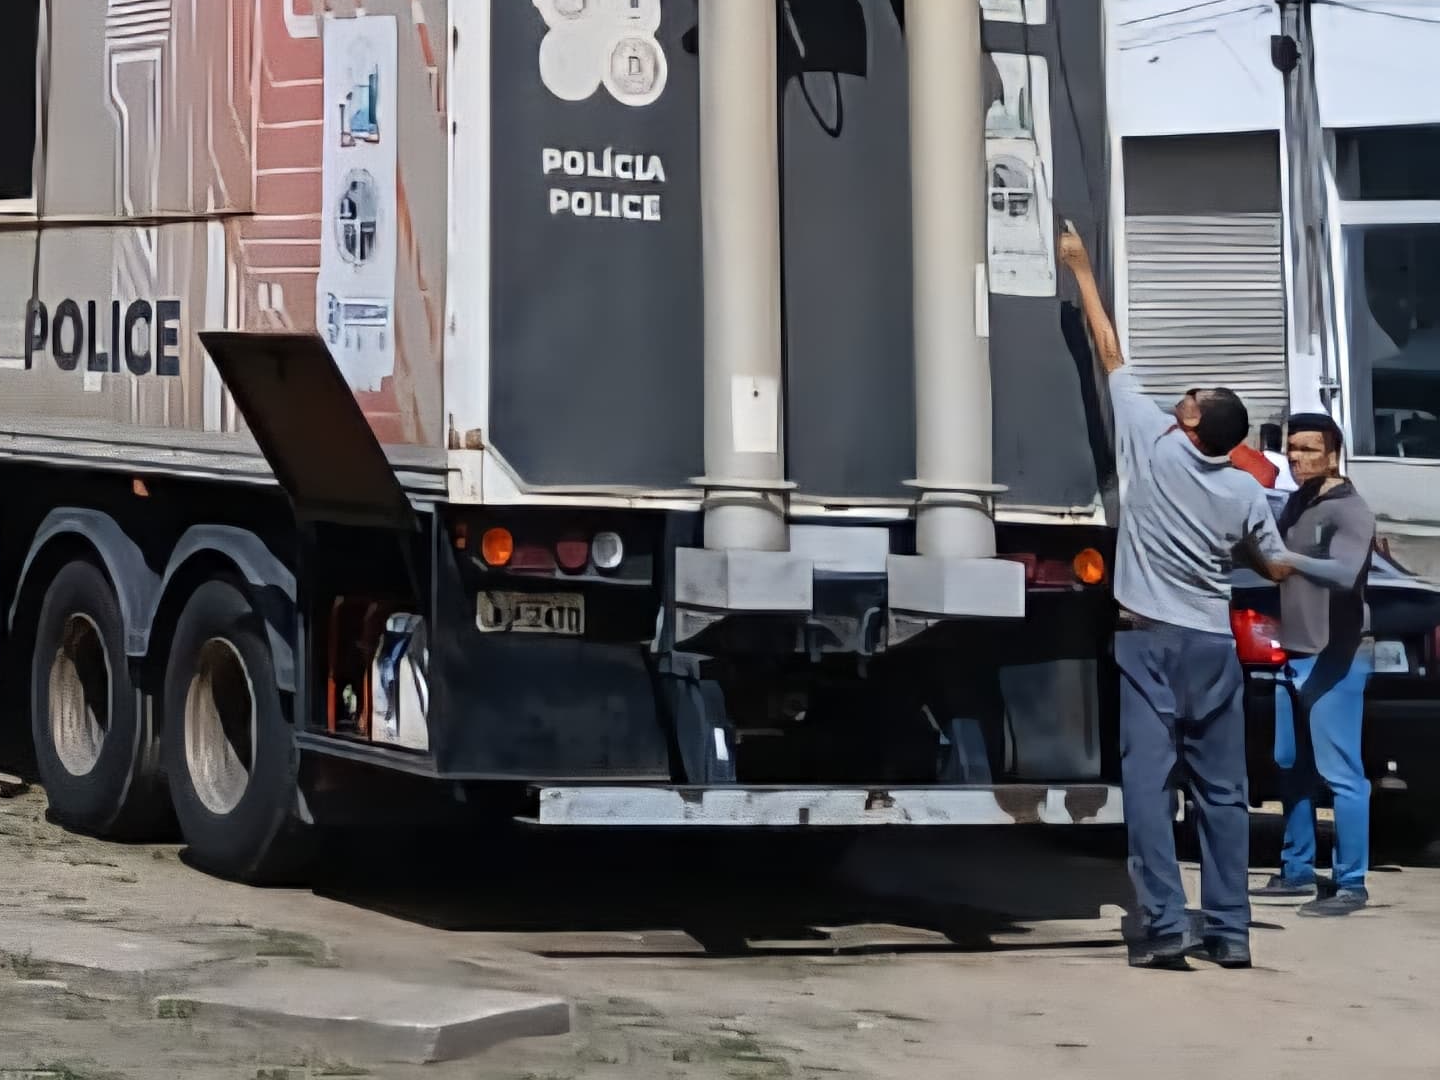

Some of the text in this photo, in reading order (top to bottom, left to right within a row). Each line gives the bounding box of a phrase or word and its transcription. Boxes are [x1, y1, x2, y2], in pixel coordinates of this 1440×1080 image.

[542, 146, 665, 182] POLÍCIA
[549, 188, 660, 221] POLICE
[25, 297, 180, 376] POLICE
